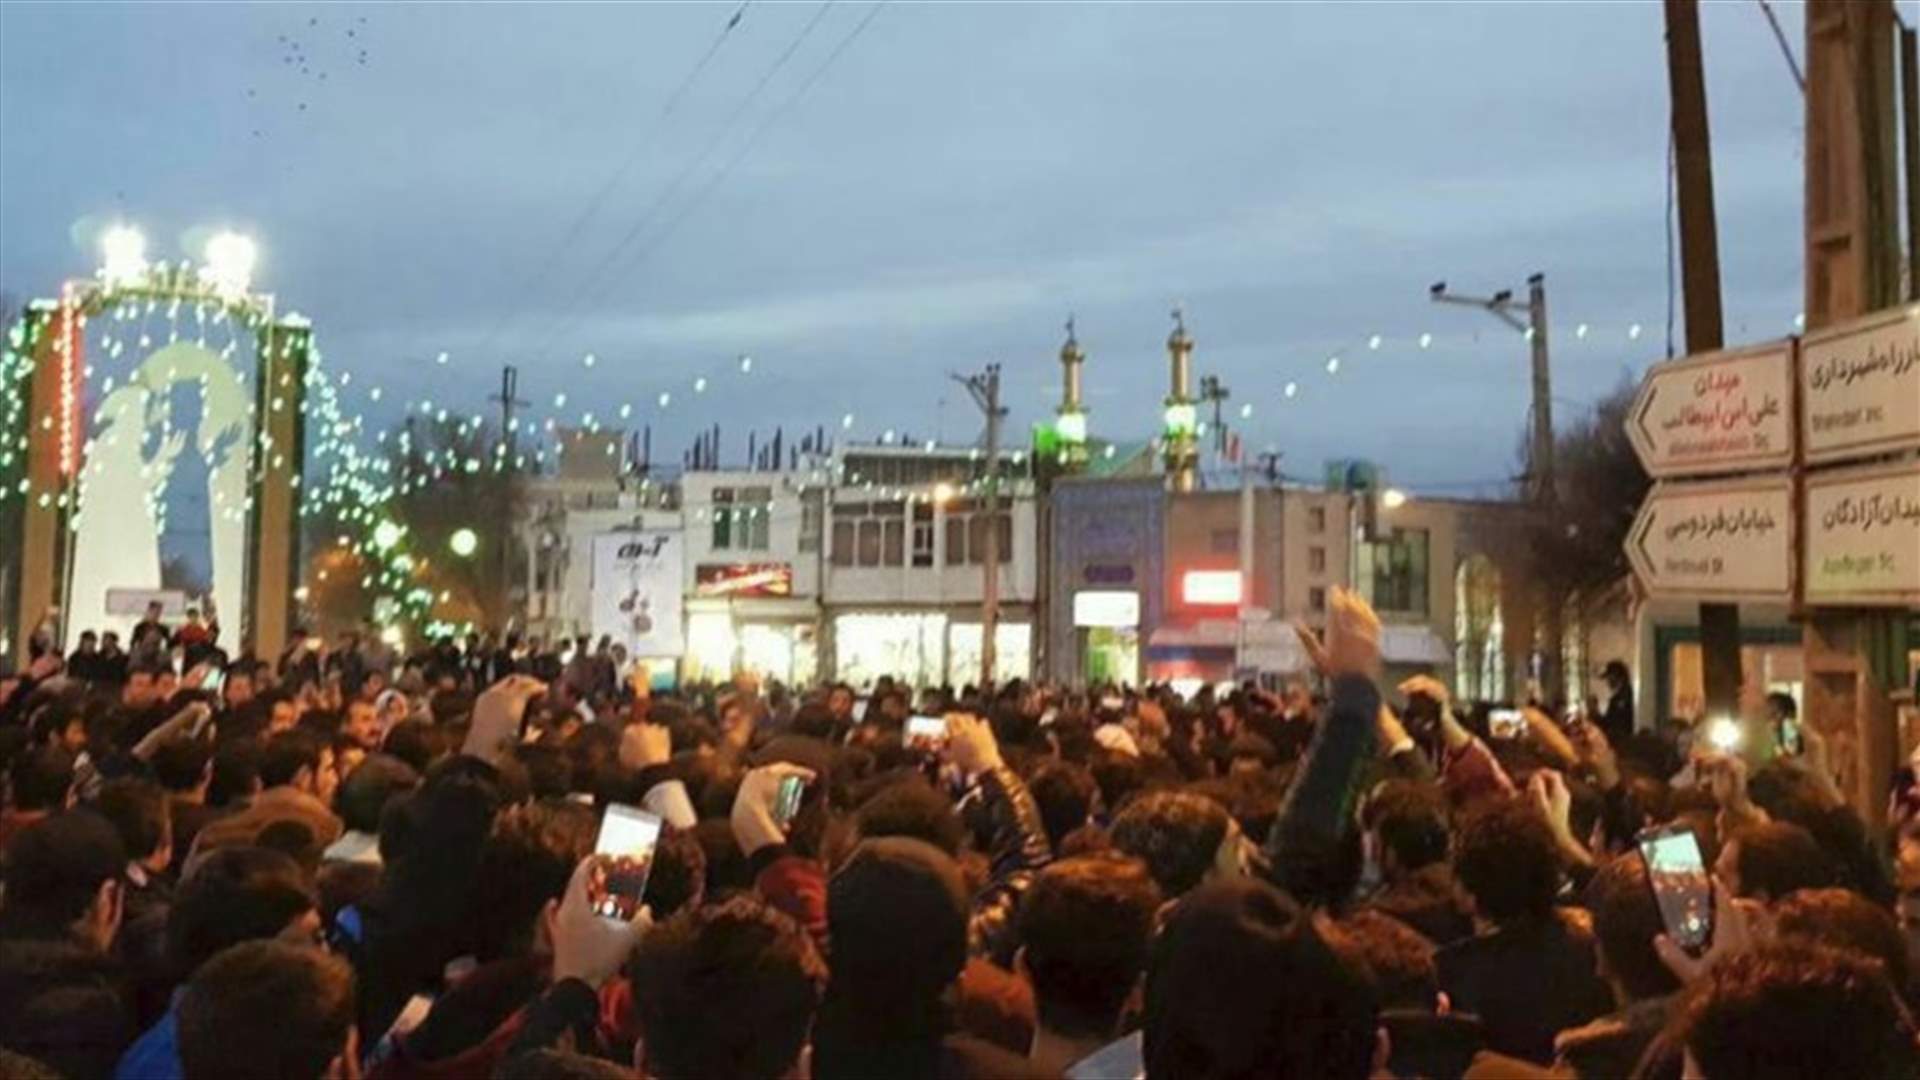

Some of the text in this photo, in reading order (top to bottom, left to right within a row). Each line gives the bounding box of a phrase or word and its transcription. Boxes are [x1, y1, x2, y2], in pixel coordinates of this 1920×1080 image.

[1694, 371, 1741, 397] میدان
[1811, 343, 1880, 392] شهرداری
[1747, 392, 1779, 427] علی
[1665, 507, 1775, 541] خیابان فردوسی
[1822, 494, 1920, 532] یدان آزادگان
